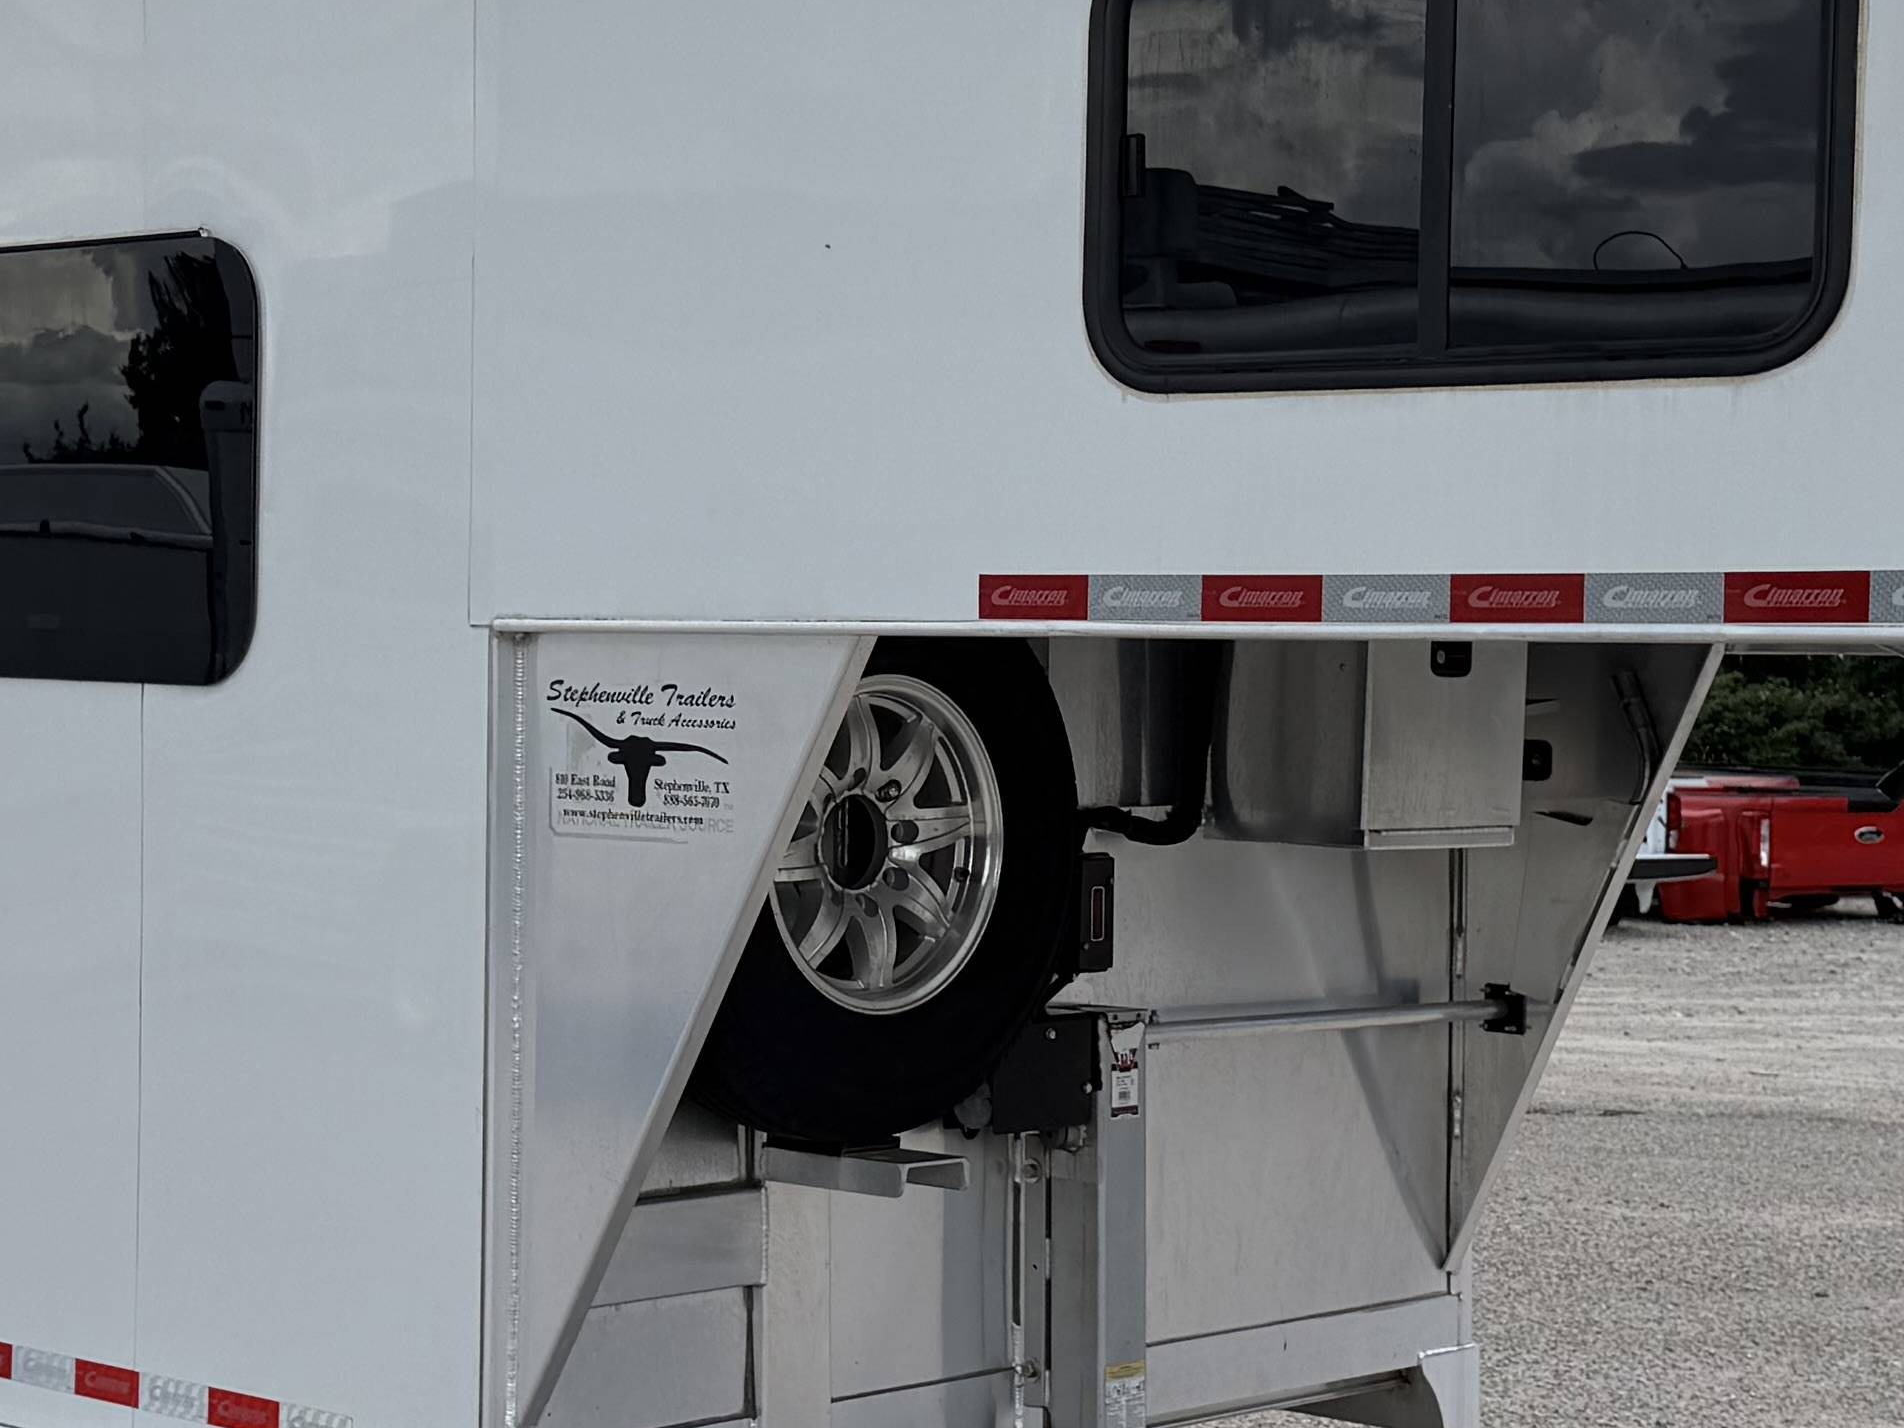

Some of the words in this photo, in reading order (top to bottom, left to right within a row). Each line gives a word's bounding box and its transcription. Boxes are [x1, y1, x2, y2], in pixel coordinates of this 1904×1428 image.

[546, 679, 654, 707] Stephenville
[660, 683, 736, 708] Trailers
[616, 710, 626, 724] &
[630, 711, 665, 726] Truck
[667, 713, 736, 730] Accessories
[571, 774, 590, 786] East
[593, 775, 616, 788] Road
[714, 781, 730, 794] TX
